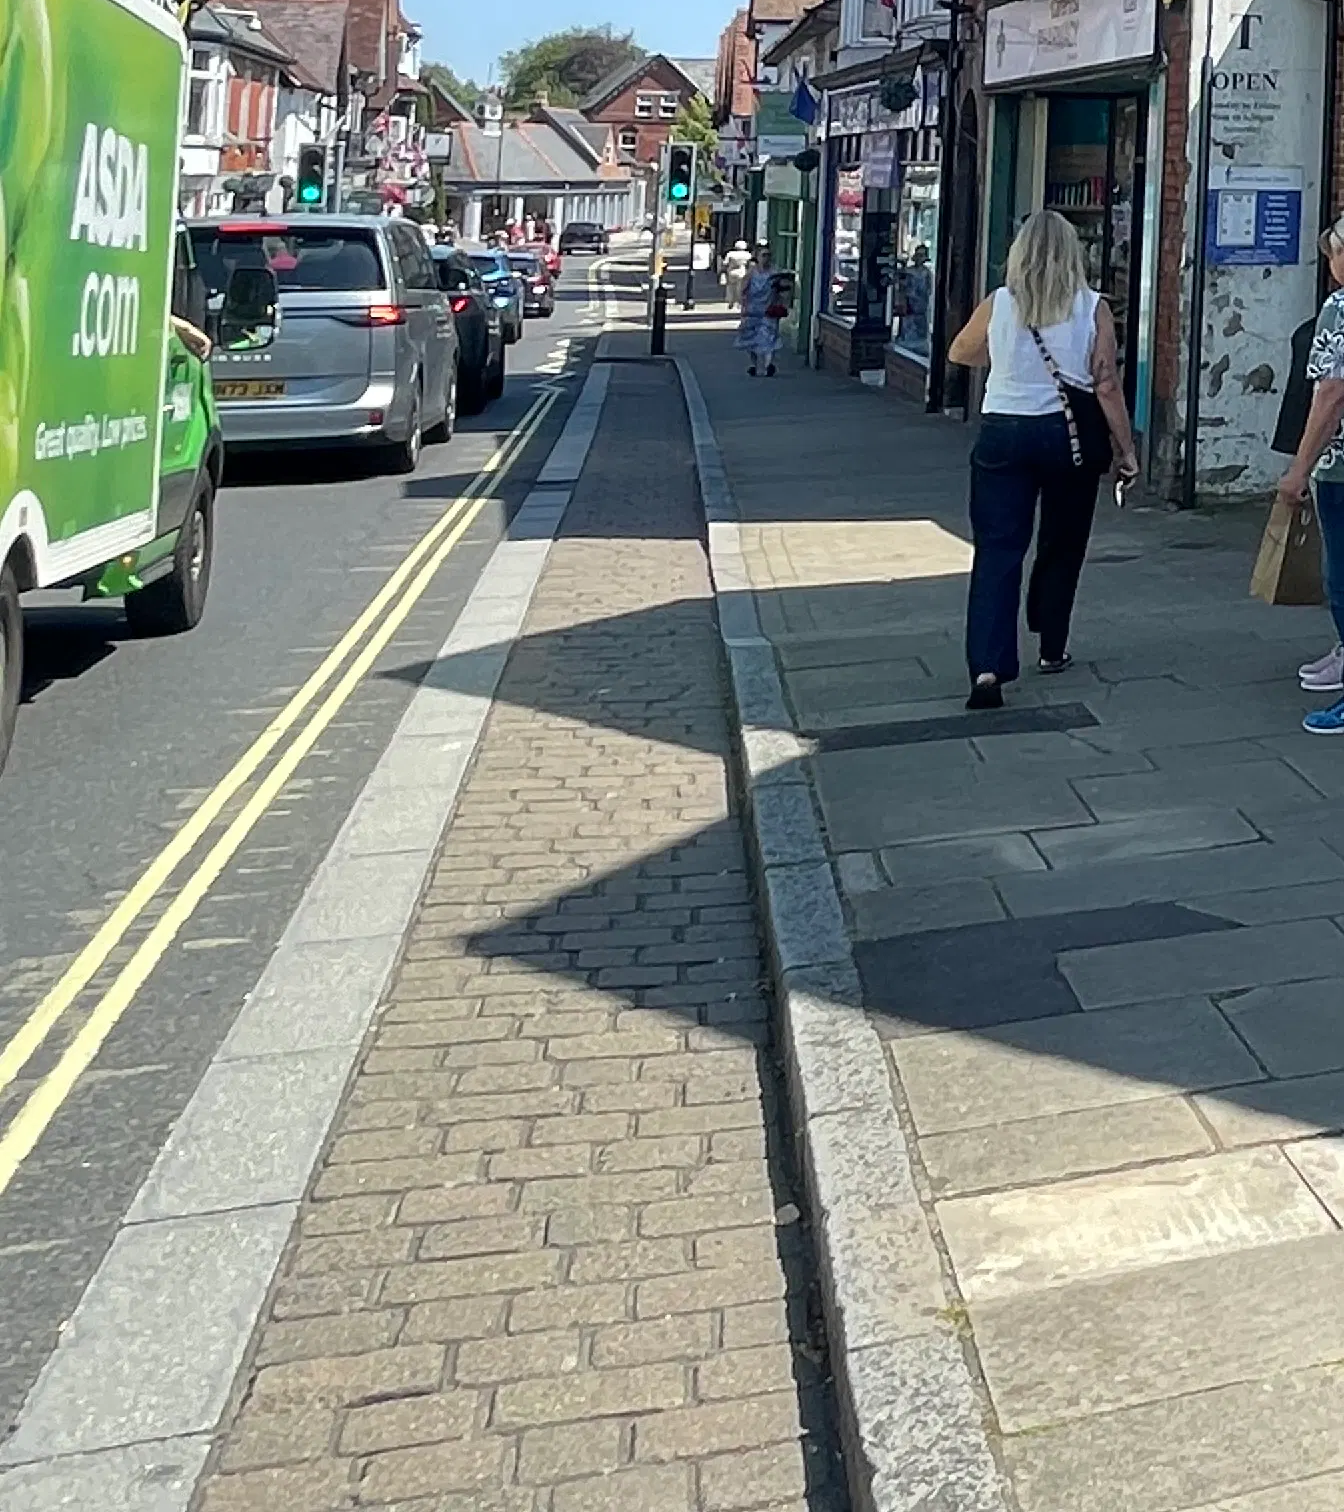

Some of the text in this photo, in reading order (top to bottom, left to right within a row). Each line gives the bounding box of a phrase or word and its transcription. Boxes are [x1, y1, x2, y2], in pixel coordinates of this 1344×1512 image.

[1212, 71, 1278, 91] OPEN
[69, 122, 148, 252] ASDA
[71, 271, 140, 358] .com
